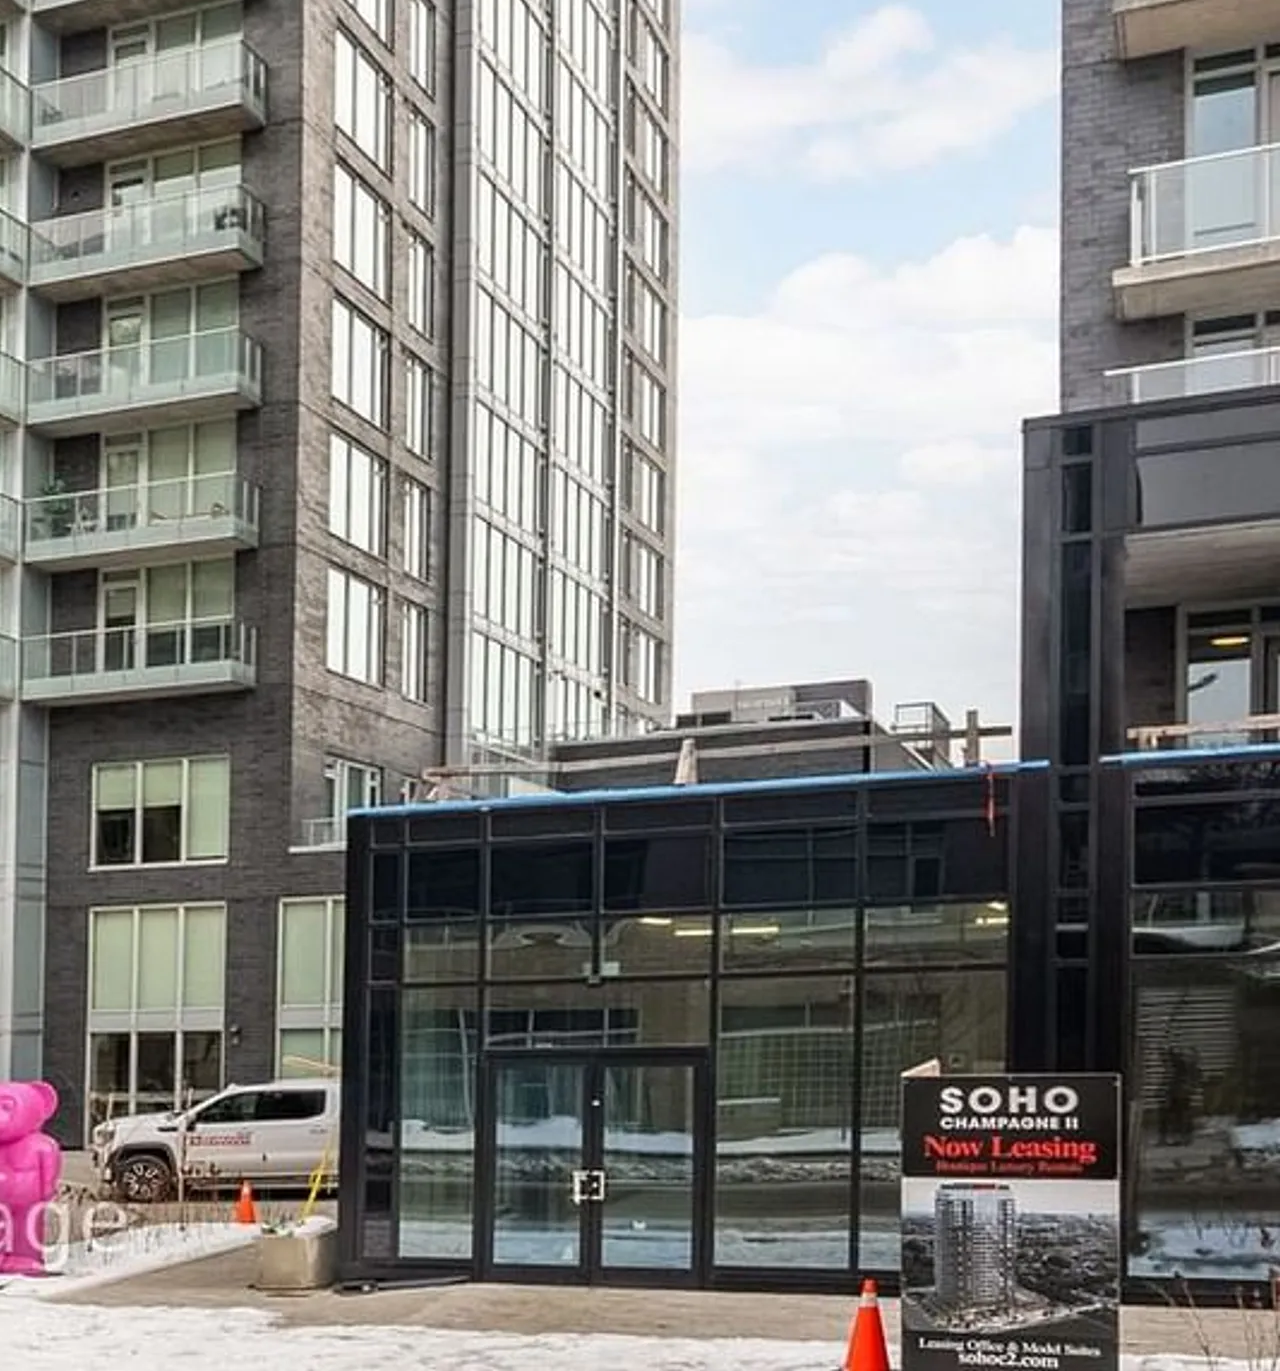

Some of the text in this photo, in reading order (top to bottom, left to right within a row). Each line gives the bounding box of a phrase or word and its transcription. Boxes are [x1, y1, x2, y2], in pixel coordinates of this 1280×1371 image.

[940, 1085, 1079, 1114] SOHO
[940, 1116, 1060, 1131] CHAMPAGNE
[923, 1133, 1098, 1164] Now Leasing
[966, 1339, 1005, 1354] Office
[1022, 1341, 1062, 1356] Model
[957, 1351, 1060, 1369] sohoc2.com
